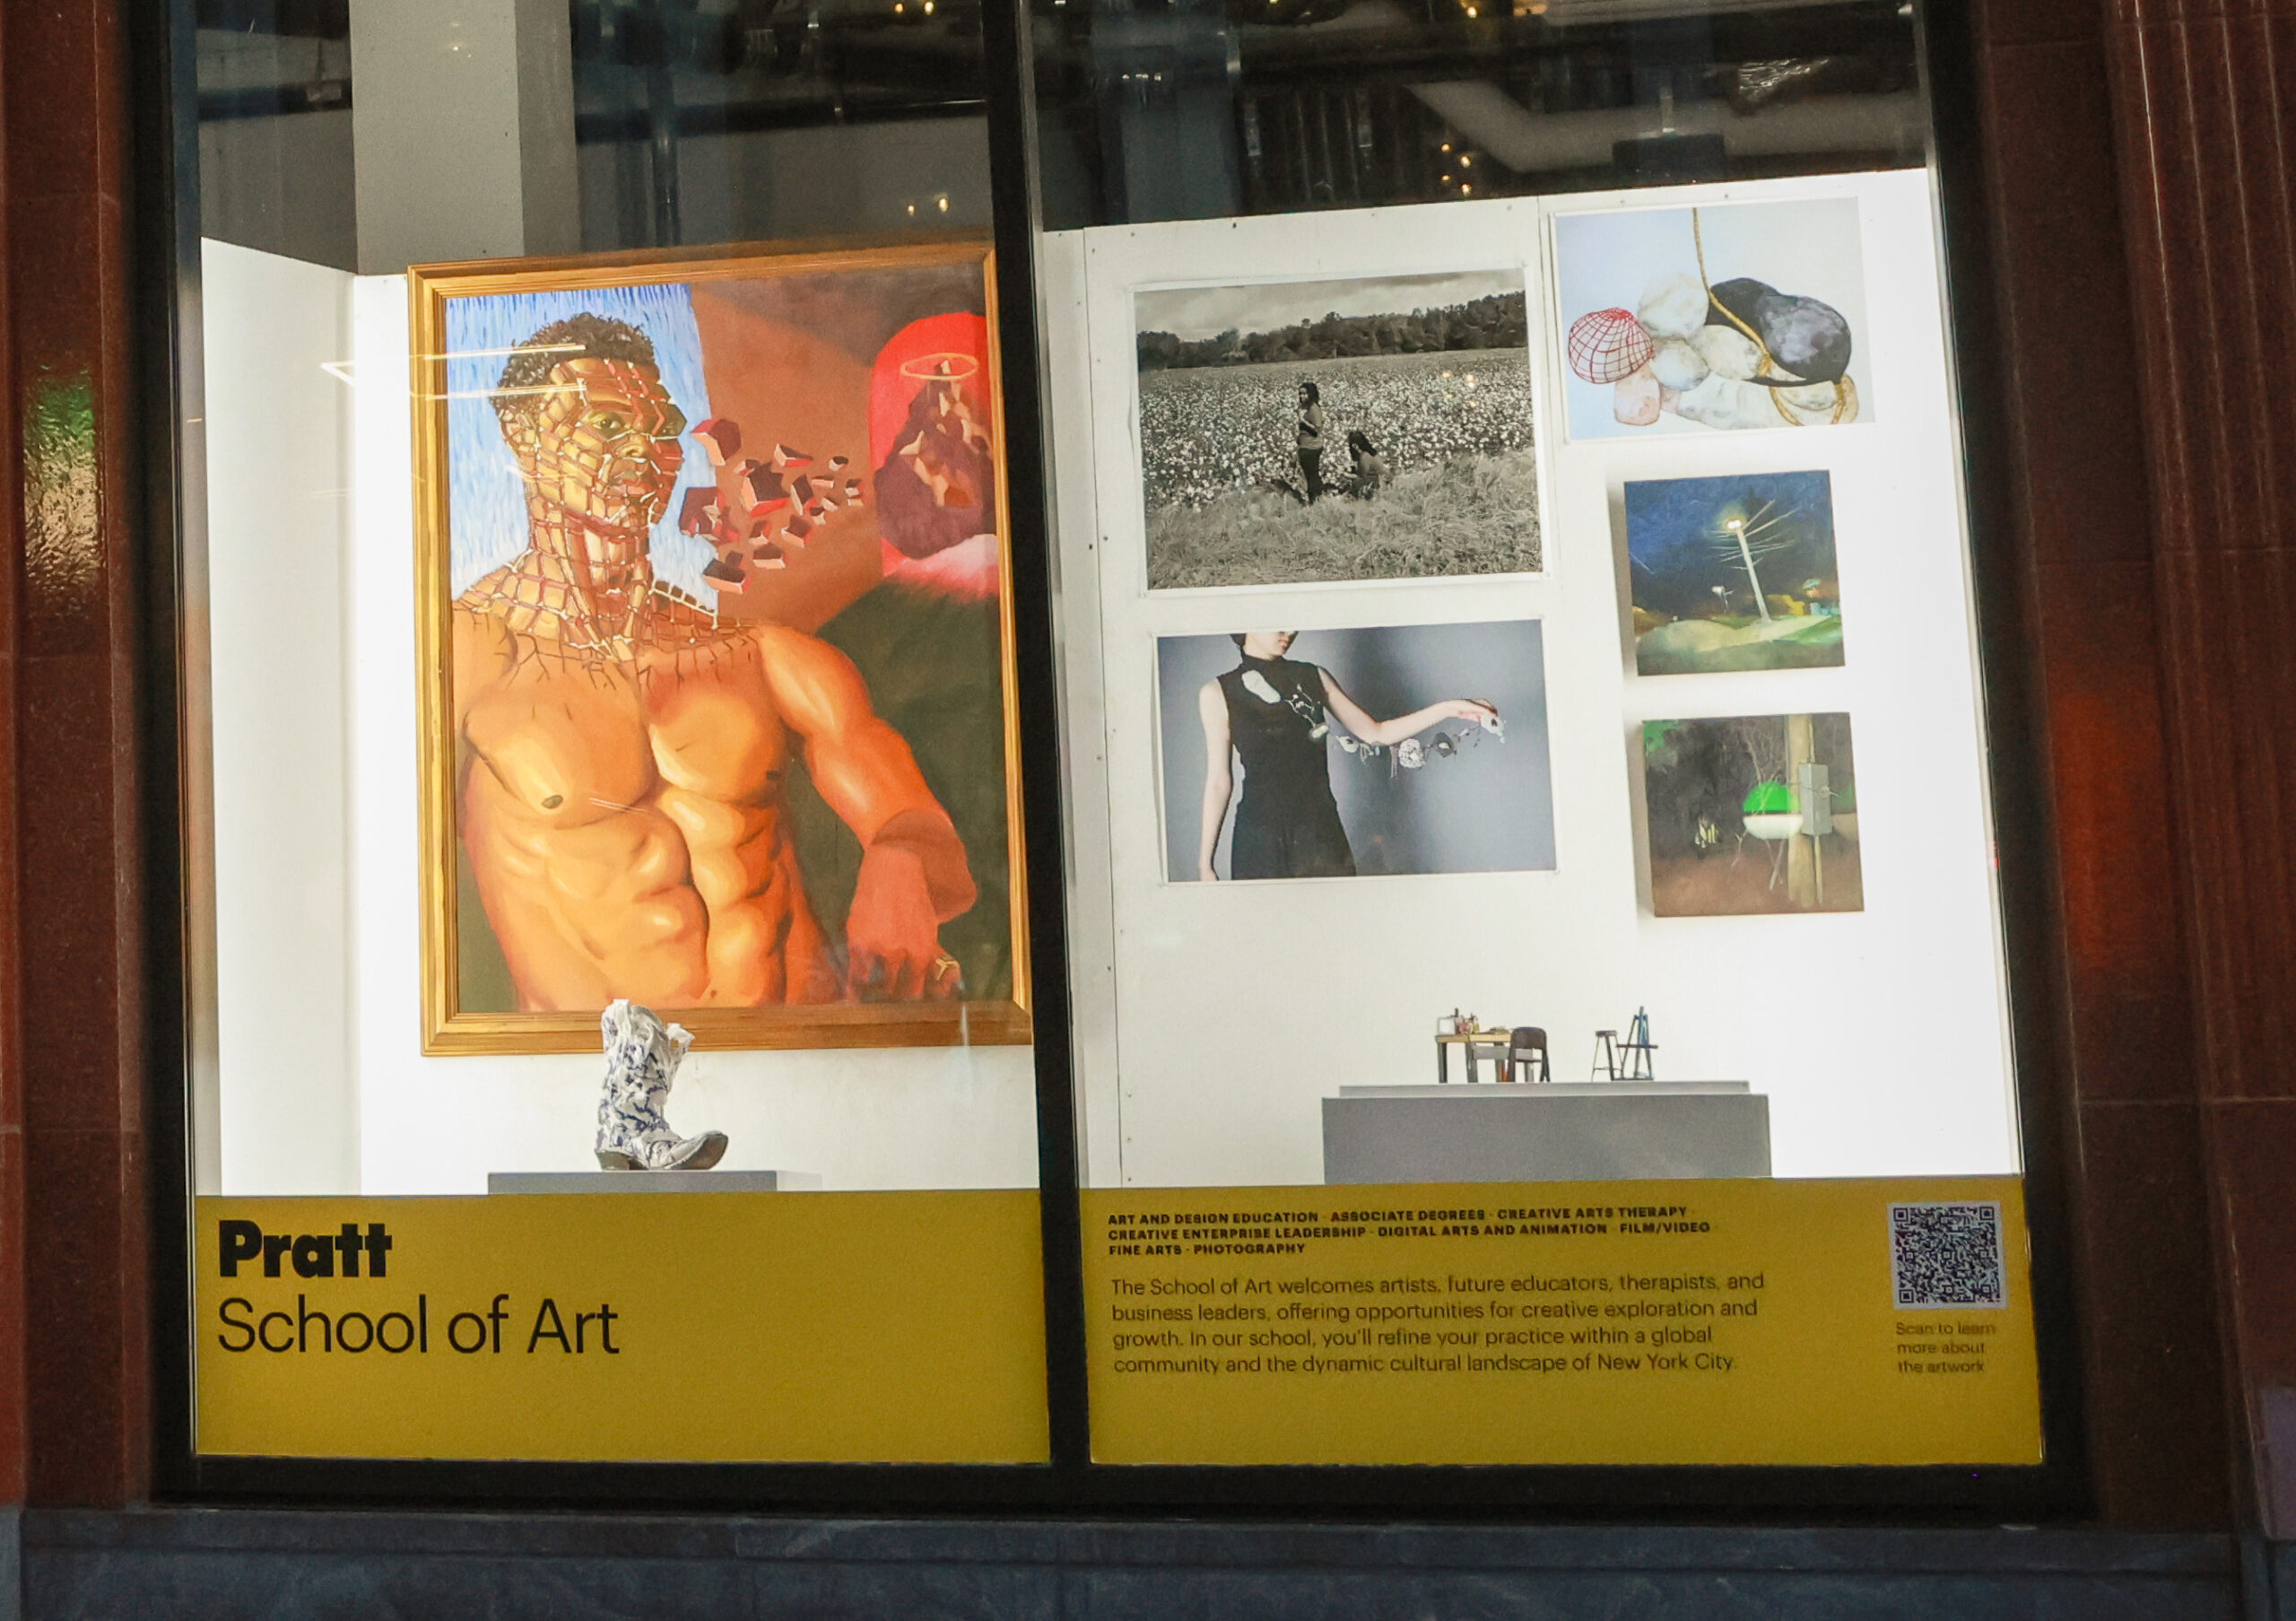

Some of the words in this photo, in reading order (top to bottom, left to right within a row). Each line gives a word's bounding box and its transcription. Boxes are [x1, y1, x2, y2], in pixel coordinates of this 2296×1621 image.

[1109, 1215, 1135, 1224] ART
[1140, 1214, 1170, 1224] AND
[1175, 1214, 1229, 1224] DESIGN
[1233, 1212, 1318, 1224] EDUCATION
[1331, 1210, 1413, 1222] ASSOCIATE
[1418, 1209, 1485, 1221] DEGREES
[1497, 1208, 1570, 1220] CREATIVE
[1576, 1207, 1613, 1218] ARTS
[1618, 1207, 1686, 1217] THERAPY
[1109, 1229, 1178, 1241] CREATIVE
[1183, 1228, 1270, 1239] ENTERPRISE
[1275, 1227, 1366, 1238] LEADERSHIP
[1378, 1226, 1436, 1237] DIGITAL
[1441, 1225, 1479, 1236] ARTS
[1483, 1224, 1516, 1235] AND
[1519, 1224, 1607, 1235] ANIMATION
[1620, 1222, 1710, 1234] FILM/VIDEO
[219, 1220, 392, 1278] Pratt
[1109, 1245, 1140, 1255] FINE
[1145, 1245, 1182, 1255] ARTS
[1194, 1243, 1305, 1255] PHOTOGRAPHY
[1112, 1279, 1145, 1295] The
[1151, 1278, 1214, 1295] School
[1221, 1277, 1238, 1294] of
[1245, 1278, 1272, 1294] Art
[1278, 1277, 1374, 1294] welcomes
[1448, 1275, 1505, 1292] future
[1510, 1275, 1613, 1292] educators,
[1727, 1272, 1764, 1290] and
[1112, 1304, 1193, 1321] business
[1198, 1303, 1270, 1320] leaders,
[1277, 1303, 1350, 1323] offering
[1356, 1303, 1484, 1322] opportunities
[1490, 1301, 1515, 1318] for
[1521, 1301, 1598, 1318] creative
[1605, 1300, 1714, 1320] exploration
[1721, 1298, 1757, 1316] and
[219, 1294, 427, 1354] School
[448, 1294, 509, 1354] of
[527, 1298, 620, 1354] Art
[1896, 1322, 1934, 1336] Scan
[1938, 1323, 1953, 1335] to
[1113, 1330, 1183, 1351] growth.
[1191, 1331, 1206, 1346] In
[1212, 1334, 1243, 1346] our
[1249, 1329, 1316, 1347] school,
[1322, 1328, 1371, 1348] you'll
[1378, 1328, 1431, 1346] refine
[1437, 1331, 1479, 1346] your
[1486, 1329, 1564, 1347] practice
[1570, 1327, 1629, 1344] within
[1635, 1331, 1645, 1344] a
[1651, 1325, 1712, 1347] global
[1897, 1344, 1936, 1354] more
[1942, 1341, 1985, 1354] about
[1114, 1357, 1220, 1375] community
[1225, 1356, 1261, 1373] and
[1267, 1356, 1297, 1372] the
[1302, 1355, 1384, 1374] dynamic
[1390, 1355, 1461, 1372] cultural
[1467, 1354, 1568, 1374] landscape
[1572, 1353, 1590, 1372] of
[1598, 1354, 1640, 1370] New
[1647, 1353, 1689, 1370] York
[1898, 1360, 1923, 1373] the
[1926, 1360, 1984, 1373] artwork
